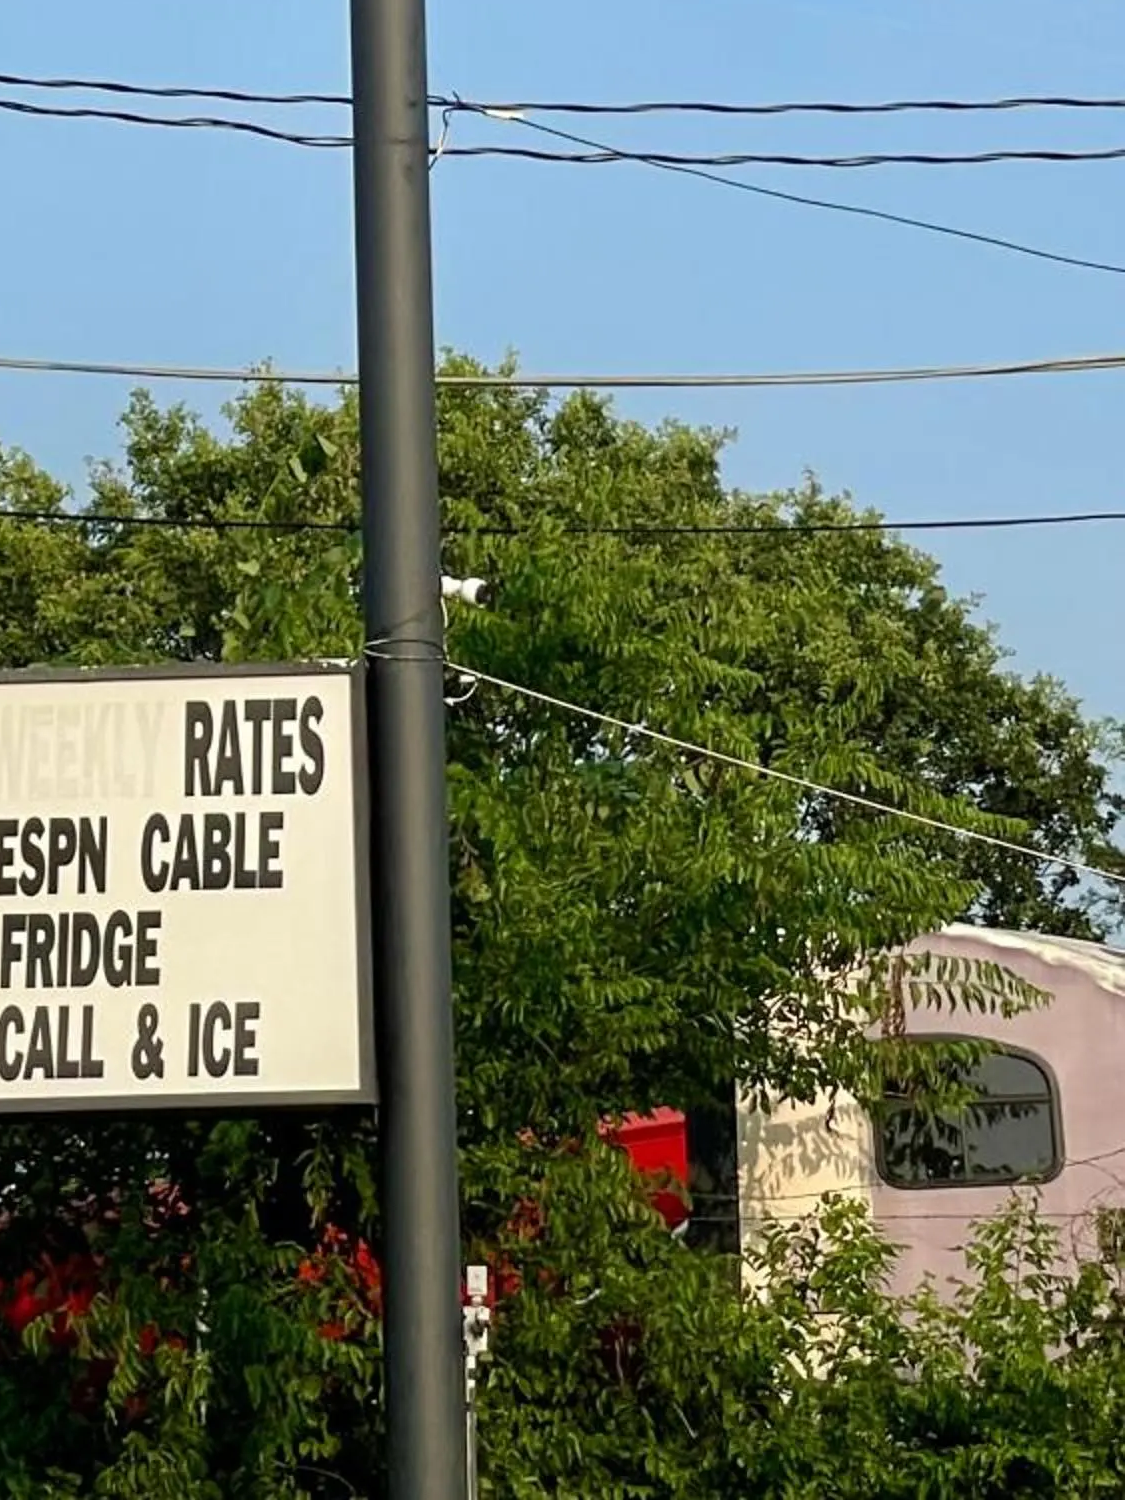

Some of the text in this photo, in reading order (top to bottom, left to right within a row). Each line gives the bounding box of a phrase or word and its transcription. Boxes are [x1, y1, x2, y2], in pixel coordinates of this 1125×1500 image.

[183, 695, 325, 797] RATES
[140, 811, 285, 894] CABLE
[0, 909, 163, 989] FRIDGE
[131, 1003, 165, 1080] &
[186, 1000, 261, 1079] ICE
